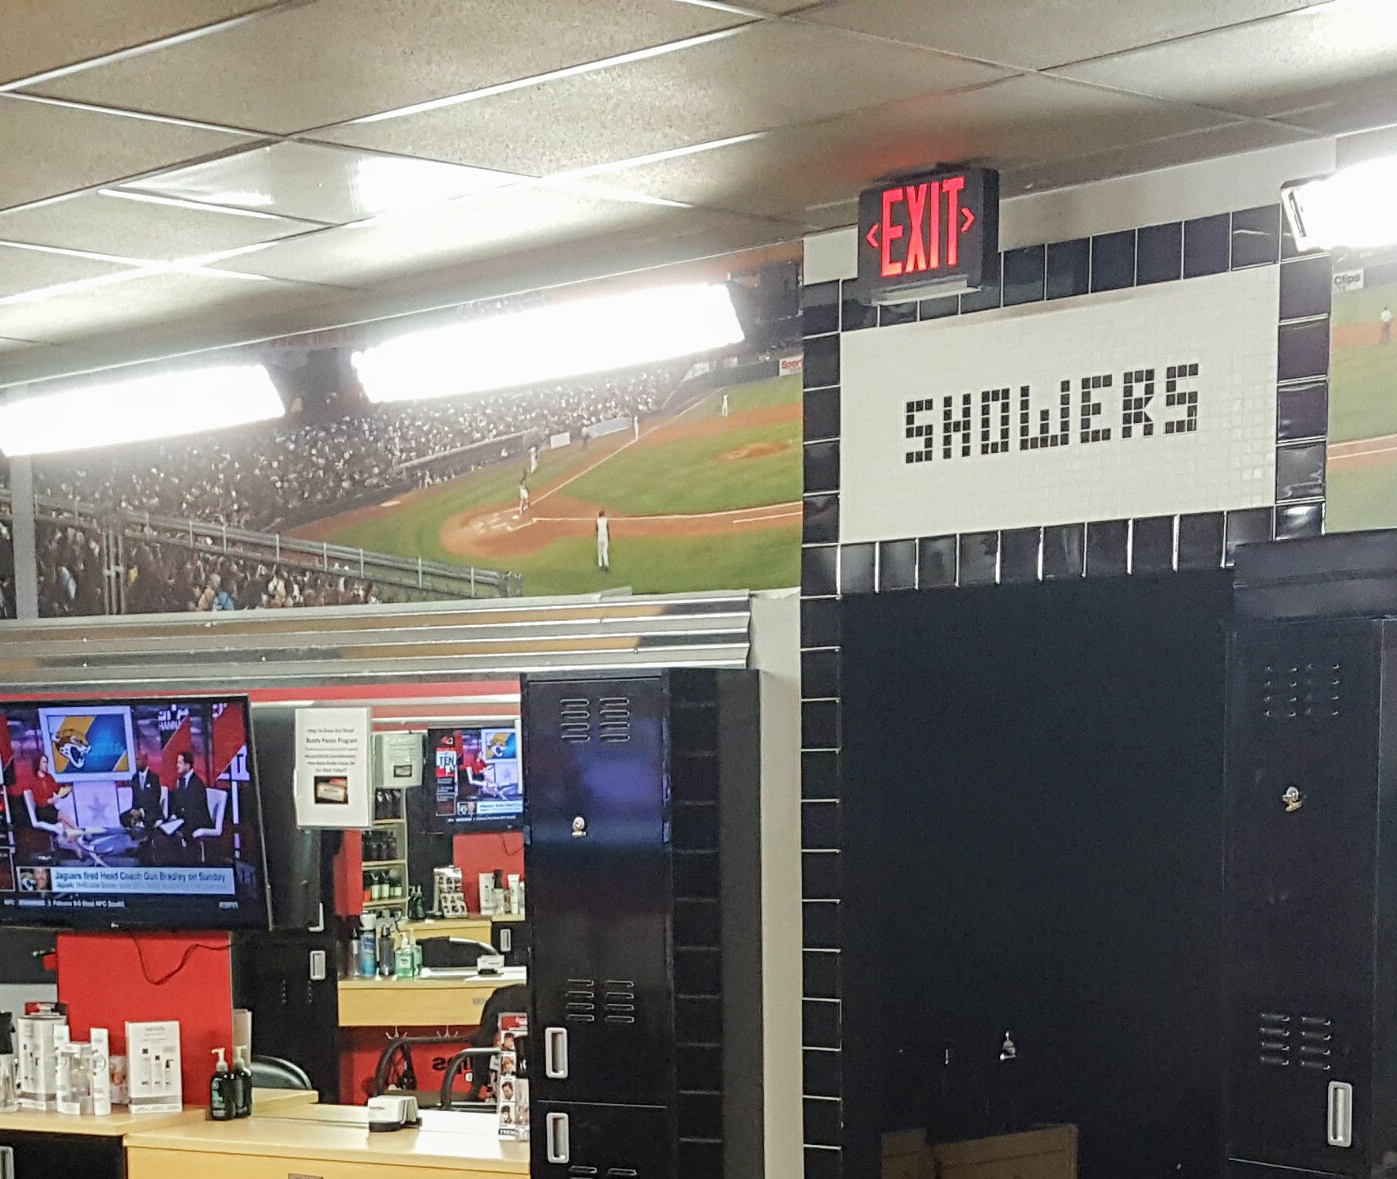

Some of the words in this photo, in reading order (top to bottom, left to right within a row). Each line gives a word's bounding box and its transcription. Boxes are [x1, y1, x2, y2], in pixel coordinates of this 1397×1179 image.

[880, 175, 966, 278] EXIT
[1333, 273, 1362, 289] Clips
[904, 363, 1200, 465] SHOWERS
[159, 872, 186, 883] Bradley
[199, 872, 225, 883] Sunday
